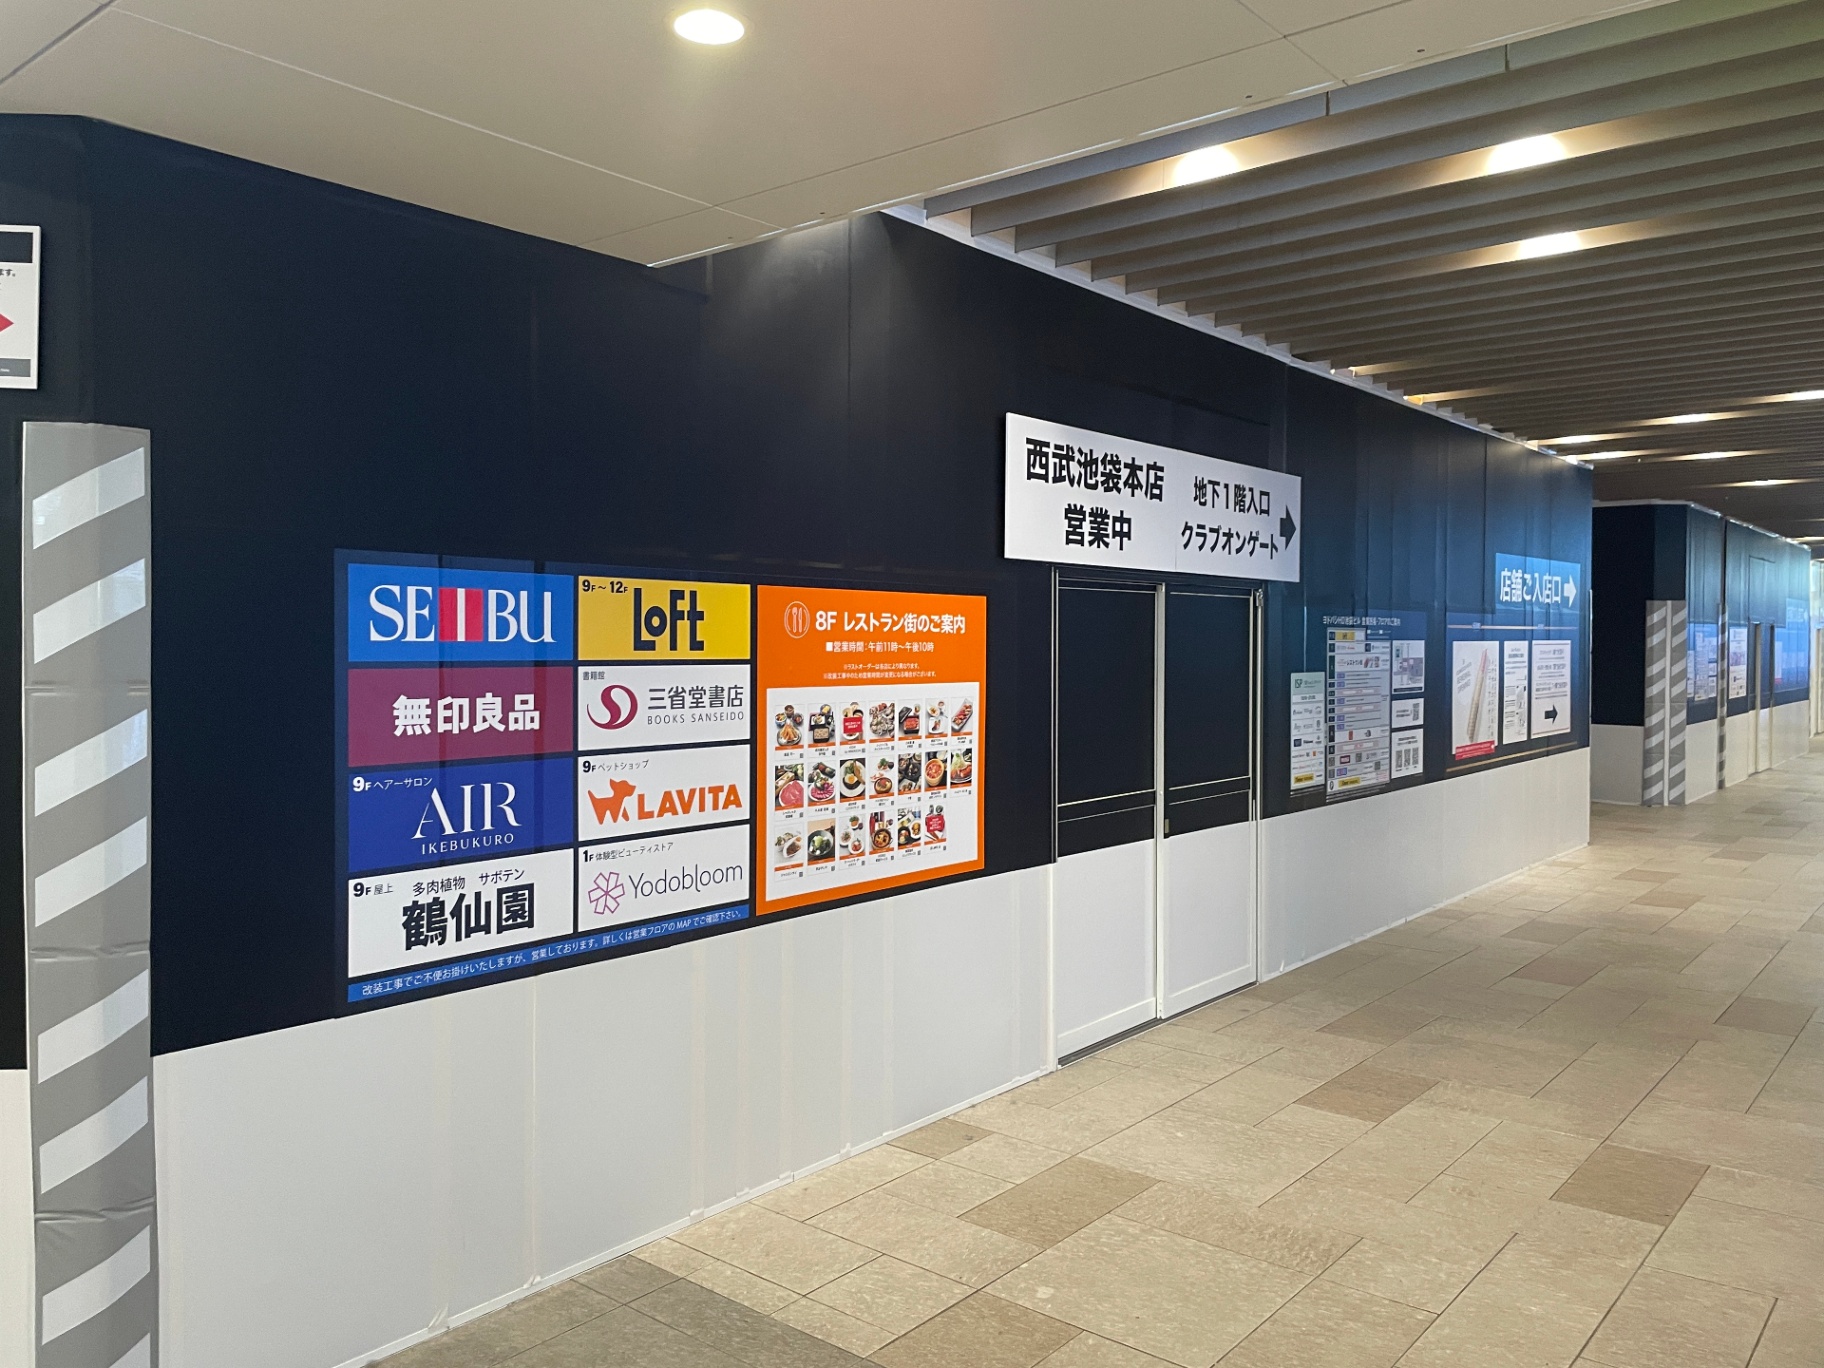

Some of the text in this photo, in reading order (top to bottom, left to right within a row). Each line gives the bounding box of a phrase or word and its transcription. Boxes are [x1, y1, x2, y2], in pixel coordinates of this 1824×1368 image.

[1026, 437, 1165, 502] 西武池袋本店
[1193, 476, 1271, 517] 地下1階入口
[1064, 504, 1133, 551] 営業中
[1181, 521, 1279, 560] クラブオンゲート
[1499, 568, 1561, 604] 店舗ご入店口
[368, 583, 557, 643] SEIBU
[815, 610, 966, 635] 8F レストラン街のご案内
[582, 671, 605, 681] 書籍館
[392, 691, 541, 737] 無印良品
[647, 684, 744, 711] 三省堂書店
[647, 711, 744, 724] BOOKS SANSEIDO
[352, 776, 433, 792] 9F ヘアーサロン
[582, 758, 650, 774] 9F ペットショップ
[411, 782, 522, 840] AIR
[637, 783, 743, 820] LAVITA
[420, 833, 514, 855] IKEBUKURO
[582, 842, 674, 863] 1F 体験型ビューティストア
[353, 882, 394, 897] 9F 屋上
[412, 868, 525, 897] 多肉植物 サボテン
[628, 863, 743, 900] Yodobloom
[402, 882, 535, 951] 鶴仙園
